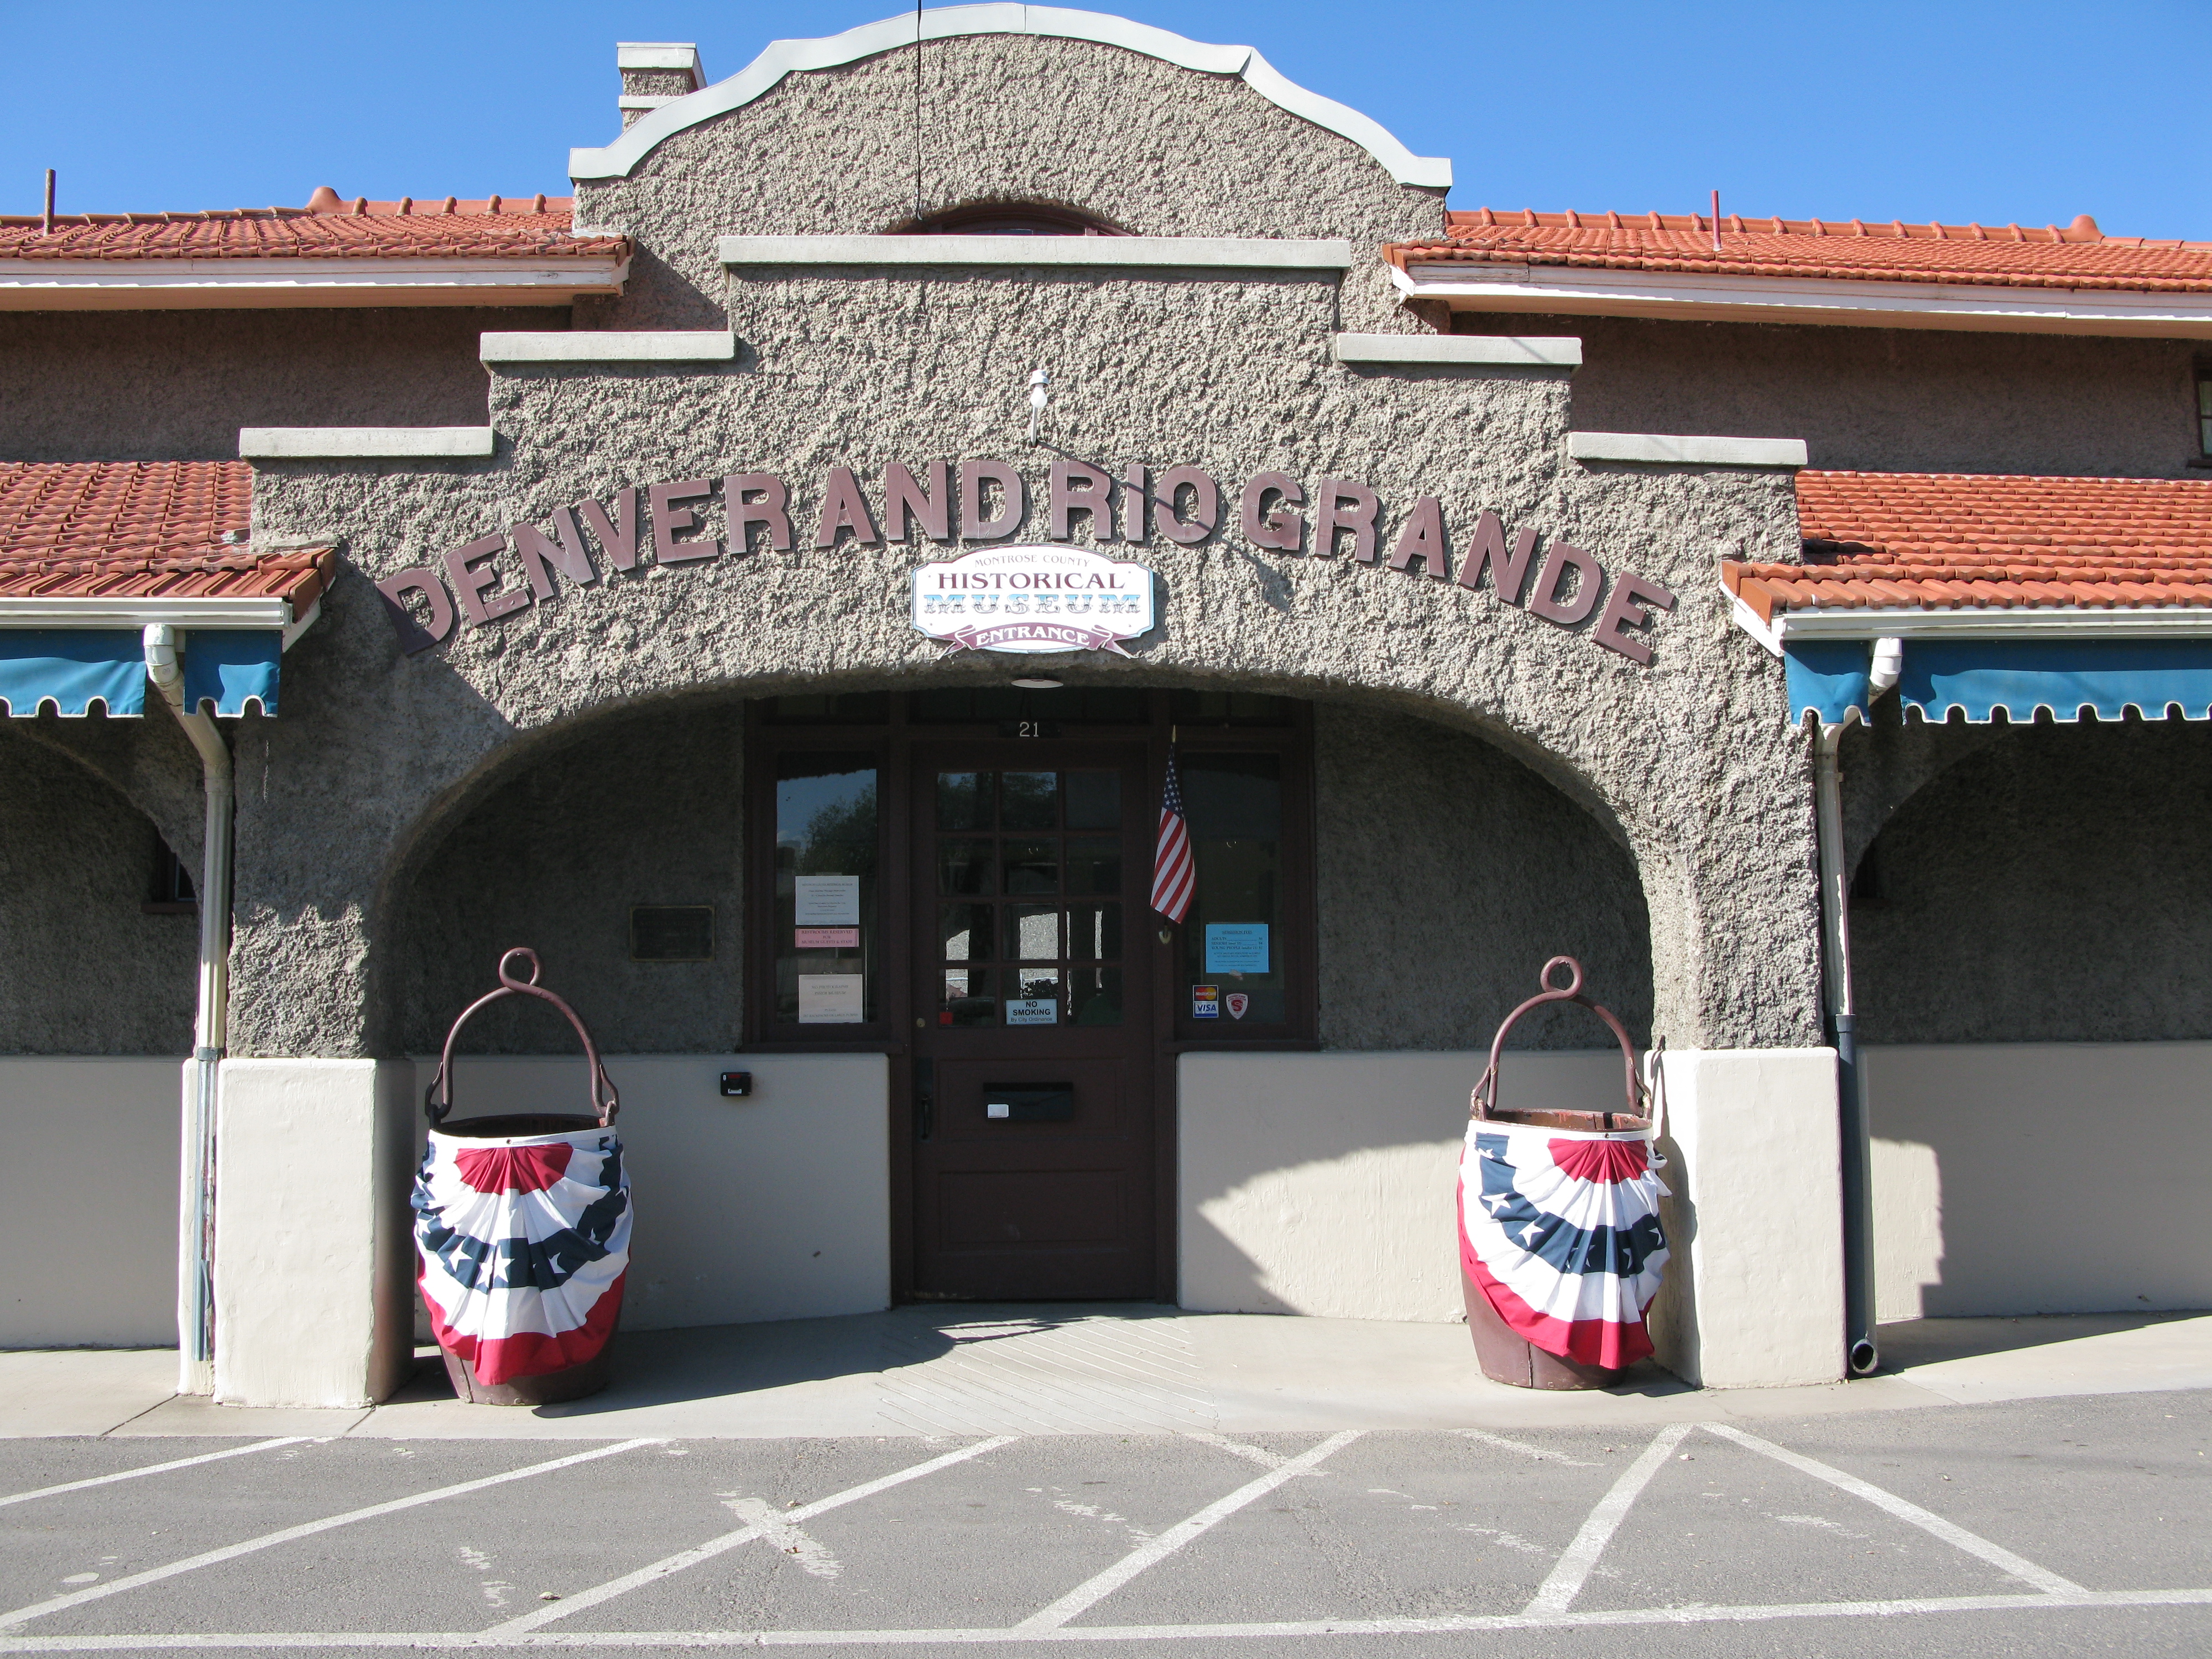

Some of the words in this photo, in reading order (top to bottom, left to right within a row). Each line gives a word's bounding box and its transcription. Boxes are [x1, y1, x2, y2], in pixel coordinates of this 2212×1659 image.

[376, 473, 791, 655] DENVER
[816, 460, 1023, 547] AND
[1051, 460, 1217, 543] RIO
[1242, 471, 1675, 665] GRANDE
[974, 554, 1038, 568] MONTROSE
[1043, 554, 1091, 568] COUNTY
[938, 573, 1125, 589] HISTORICAL
[923, 594, 1141, 614] MUSEUM
[975, 625, 1090, 646] ENTRANCE
[1020, 722, 1039, 737] 21
